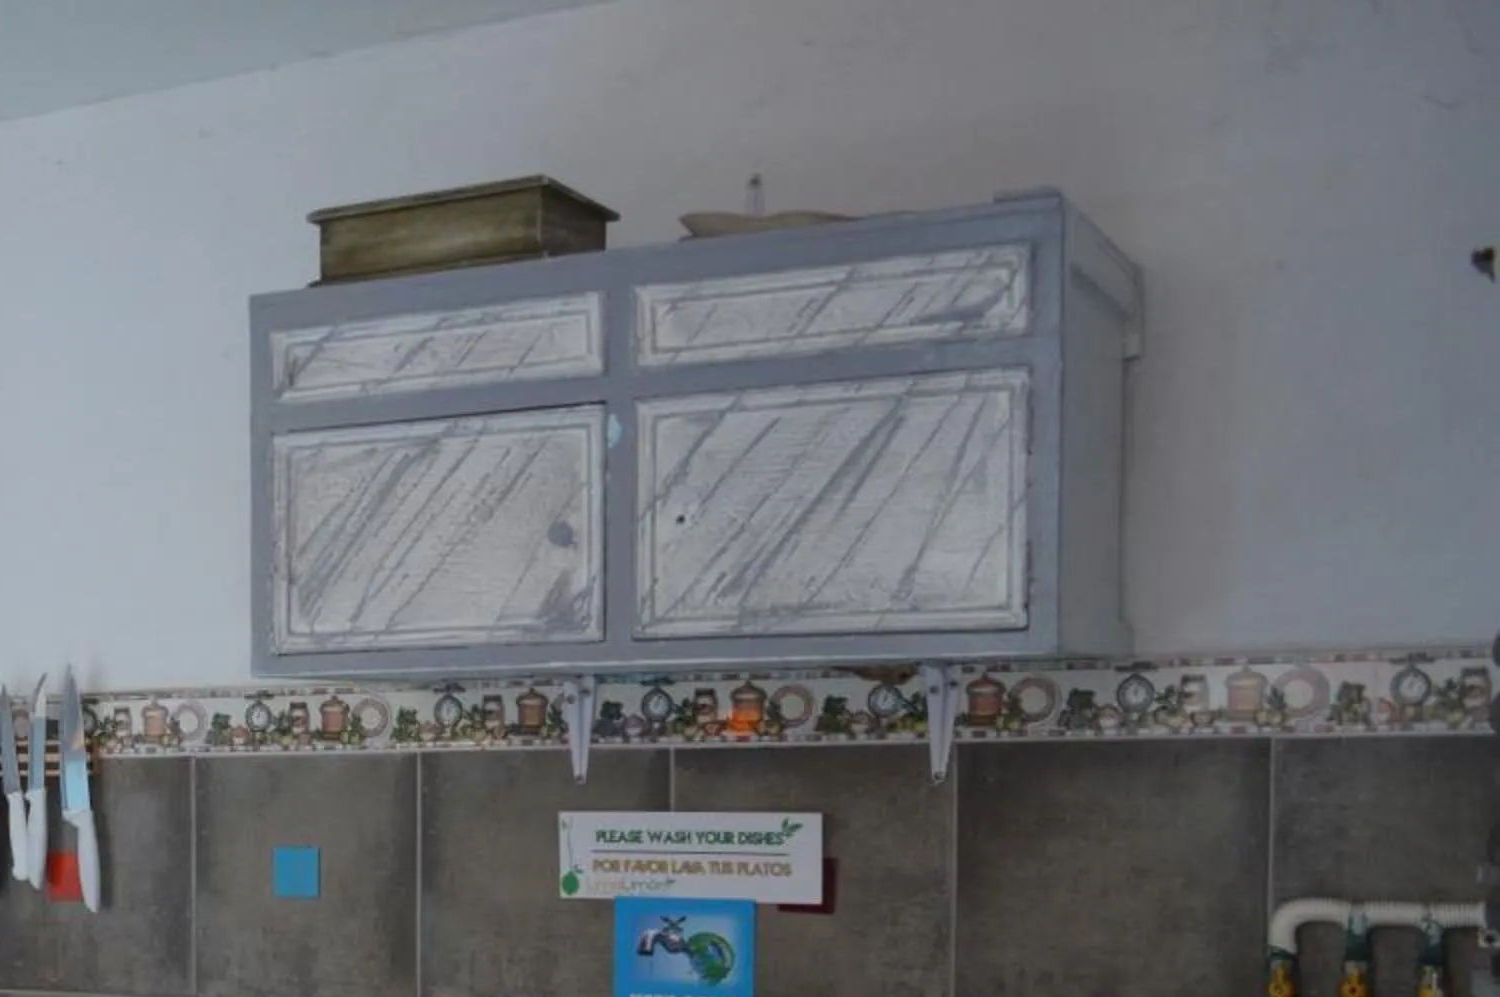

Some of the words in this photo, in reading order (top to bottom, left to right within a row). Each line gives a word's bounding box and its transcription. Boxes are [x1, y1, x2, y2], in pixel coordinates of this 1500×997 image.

[595, 829, 643, 844] PLEASE
[647, 830, 692, 845] WASH
[695, 831, 734, 845] YOUR
[737, 831, 785, 846] DISHES
[592, 859, 619, 873] POR
[623, 859, 669, 874] FAVOR
[737, 861, 792, 877] PLATOS
